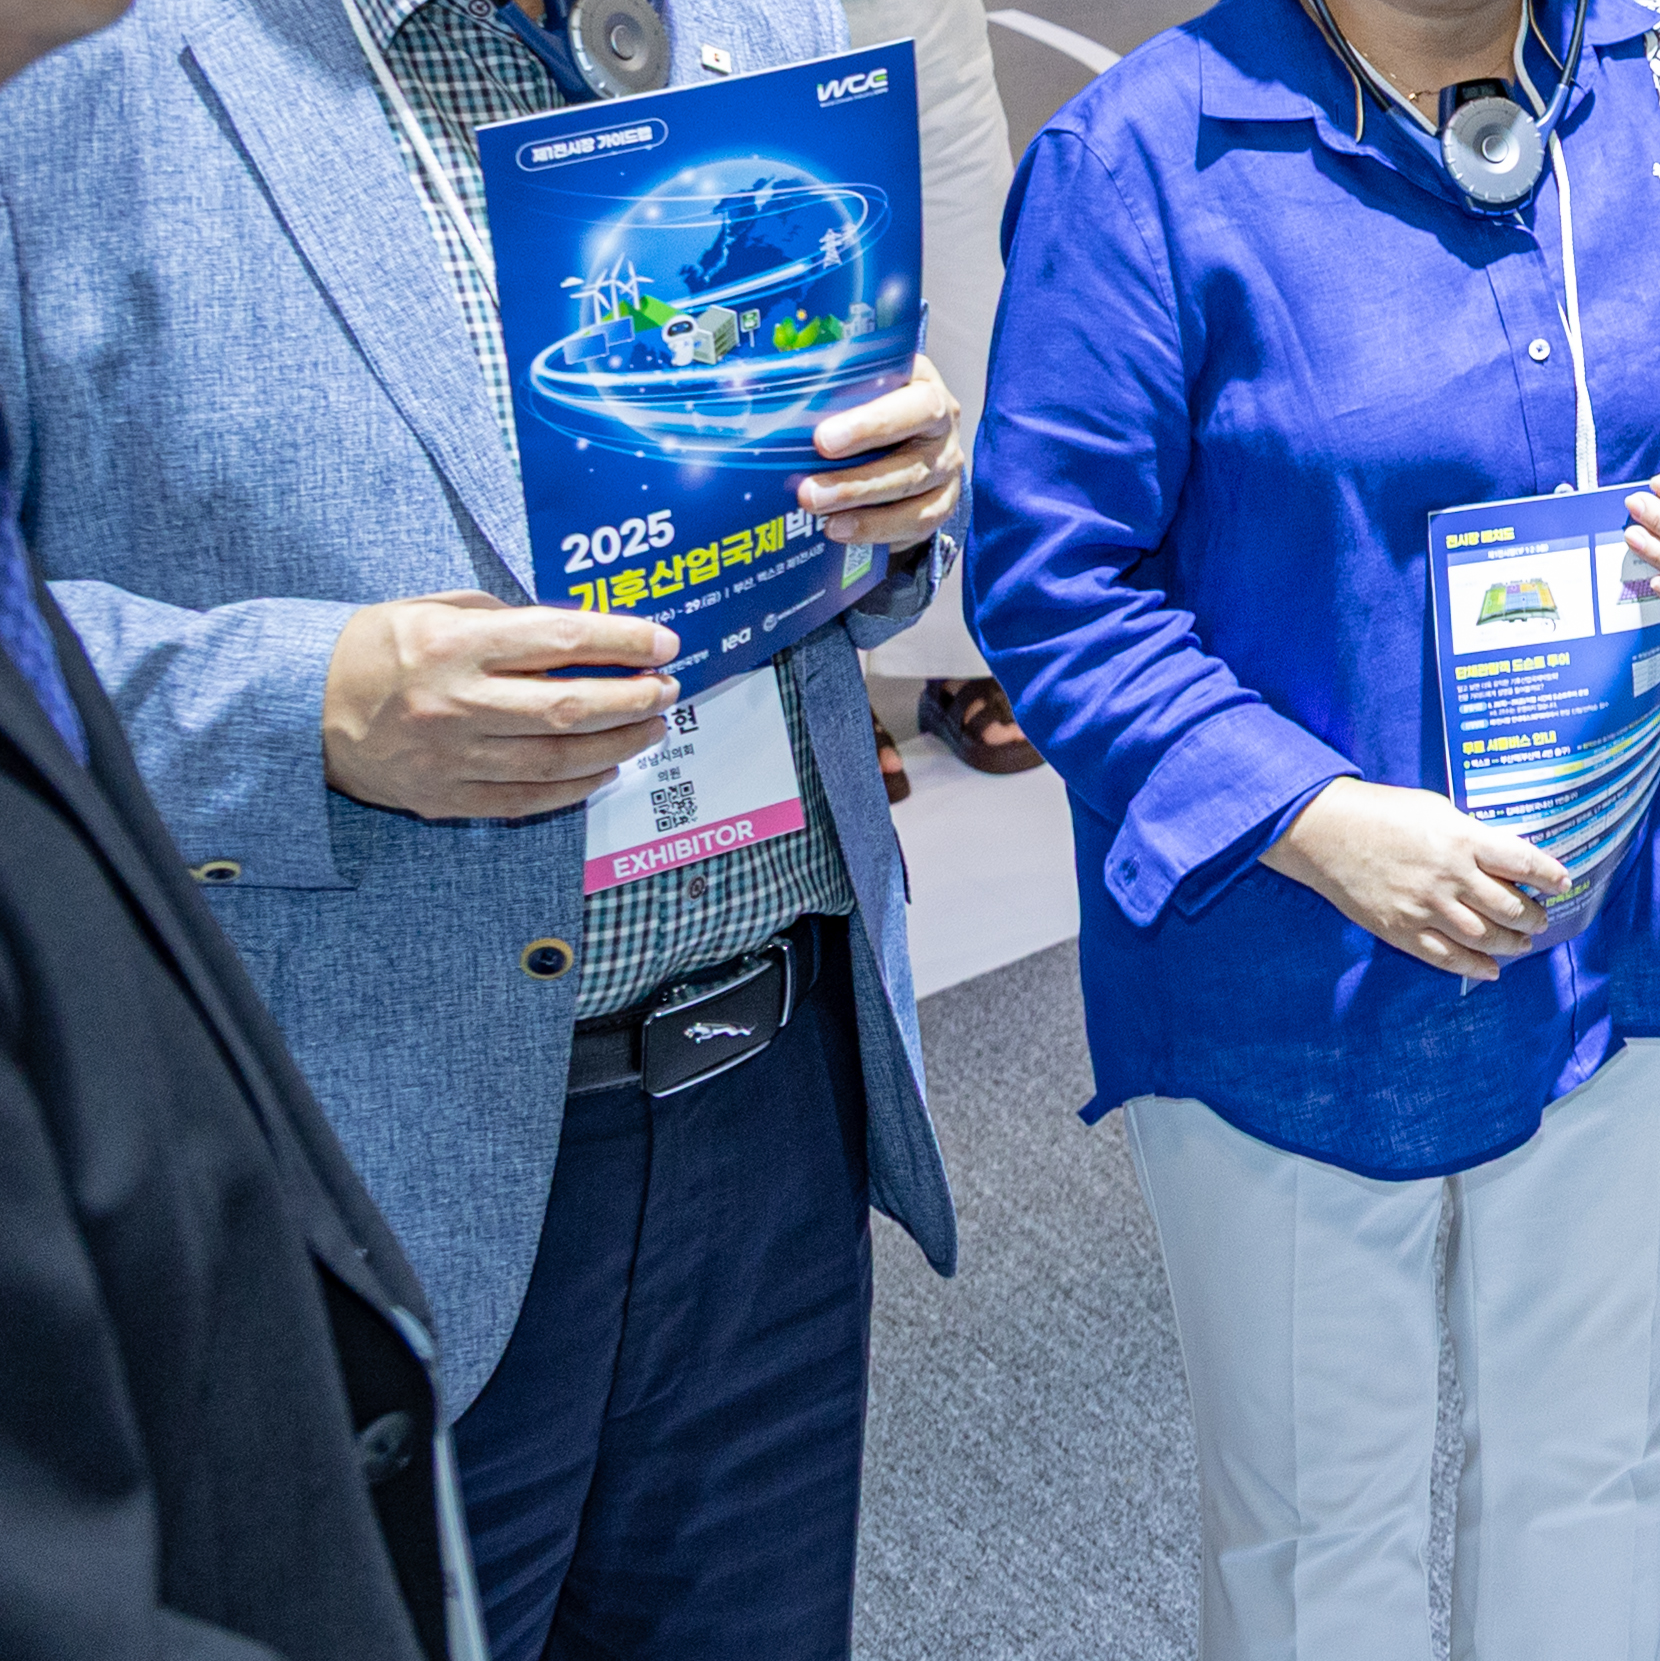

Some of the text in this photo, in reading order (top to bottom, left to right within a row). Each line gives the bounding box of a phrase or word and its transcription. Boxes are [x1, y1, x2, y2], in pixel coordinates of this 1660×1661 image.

[816, 68, 888, 102] WCE
[531, 136, 596, 163] 제1전시장
[561, 509, 675, 574] 2025
[568, 507, 828, 614] 기후산업국제박
[637, 743, 695, 770] 성남시의회
[657, 766, 682, 783] 의원
[613, 819, 755, 880] EXHIBITOR
